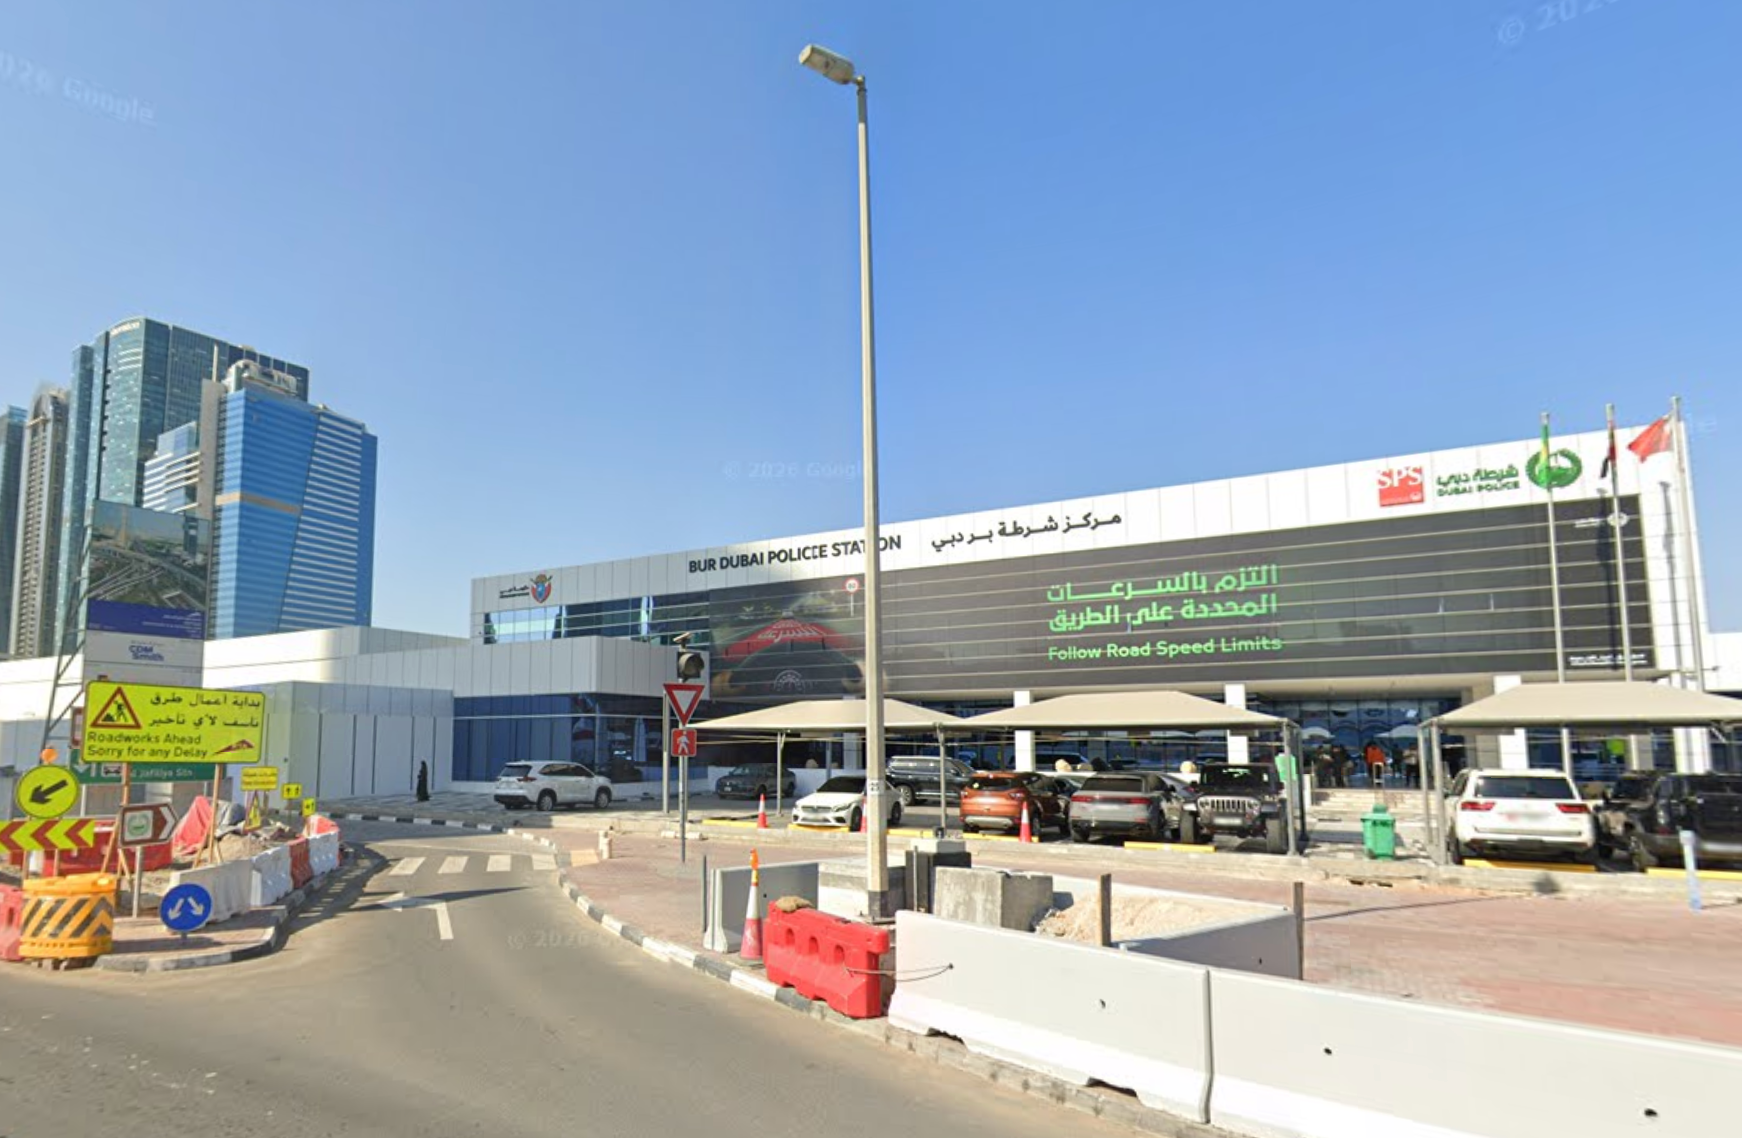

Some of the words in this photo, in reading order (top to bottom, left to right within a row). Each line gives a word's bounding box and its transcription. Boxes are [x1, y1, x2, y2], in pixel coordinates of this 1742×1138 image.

[1378, 466, 1422, 488] SPS
[1476, 480, 1520, 492] POLICE
[997, 515, 1059, 538] شرطة
[1062, 512, 1122, 533] مركز
[688, 558, 717, 573] BUR
[719, 553, 764, 570] DUBAI
[831, 534, 902, 557] STATON
[931, 531, 965, 552] دبي
[1047, 570, 1208, 602] بالسرعات
[1214, 564, 1278, 593] التزم
[1048, 604, 1120, 632] الطريق
[1126, 601, 1174, 626] على
[1180, 593, 1277, 619] المحددة
[1048, 646, 1102, 661] Follow
[1106, 642, 1151, 658] Road
[1156, 639, 1216, 659] Speed
[1221, 635, 1283, 653] Limits
[87, 731, 160, 744] Roadworks
[163, 733, 202, 744] Ahead
[87, 745, 123, 758] Sorry
[127, 745, 146, 757] for
[148, 748, 171, 759] any
[174, 746, 208, 759] Delay
